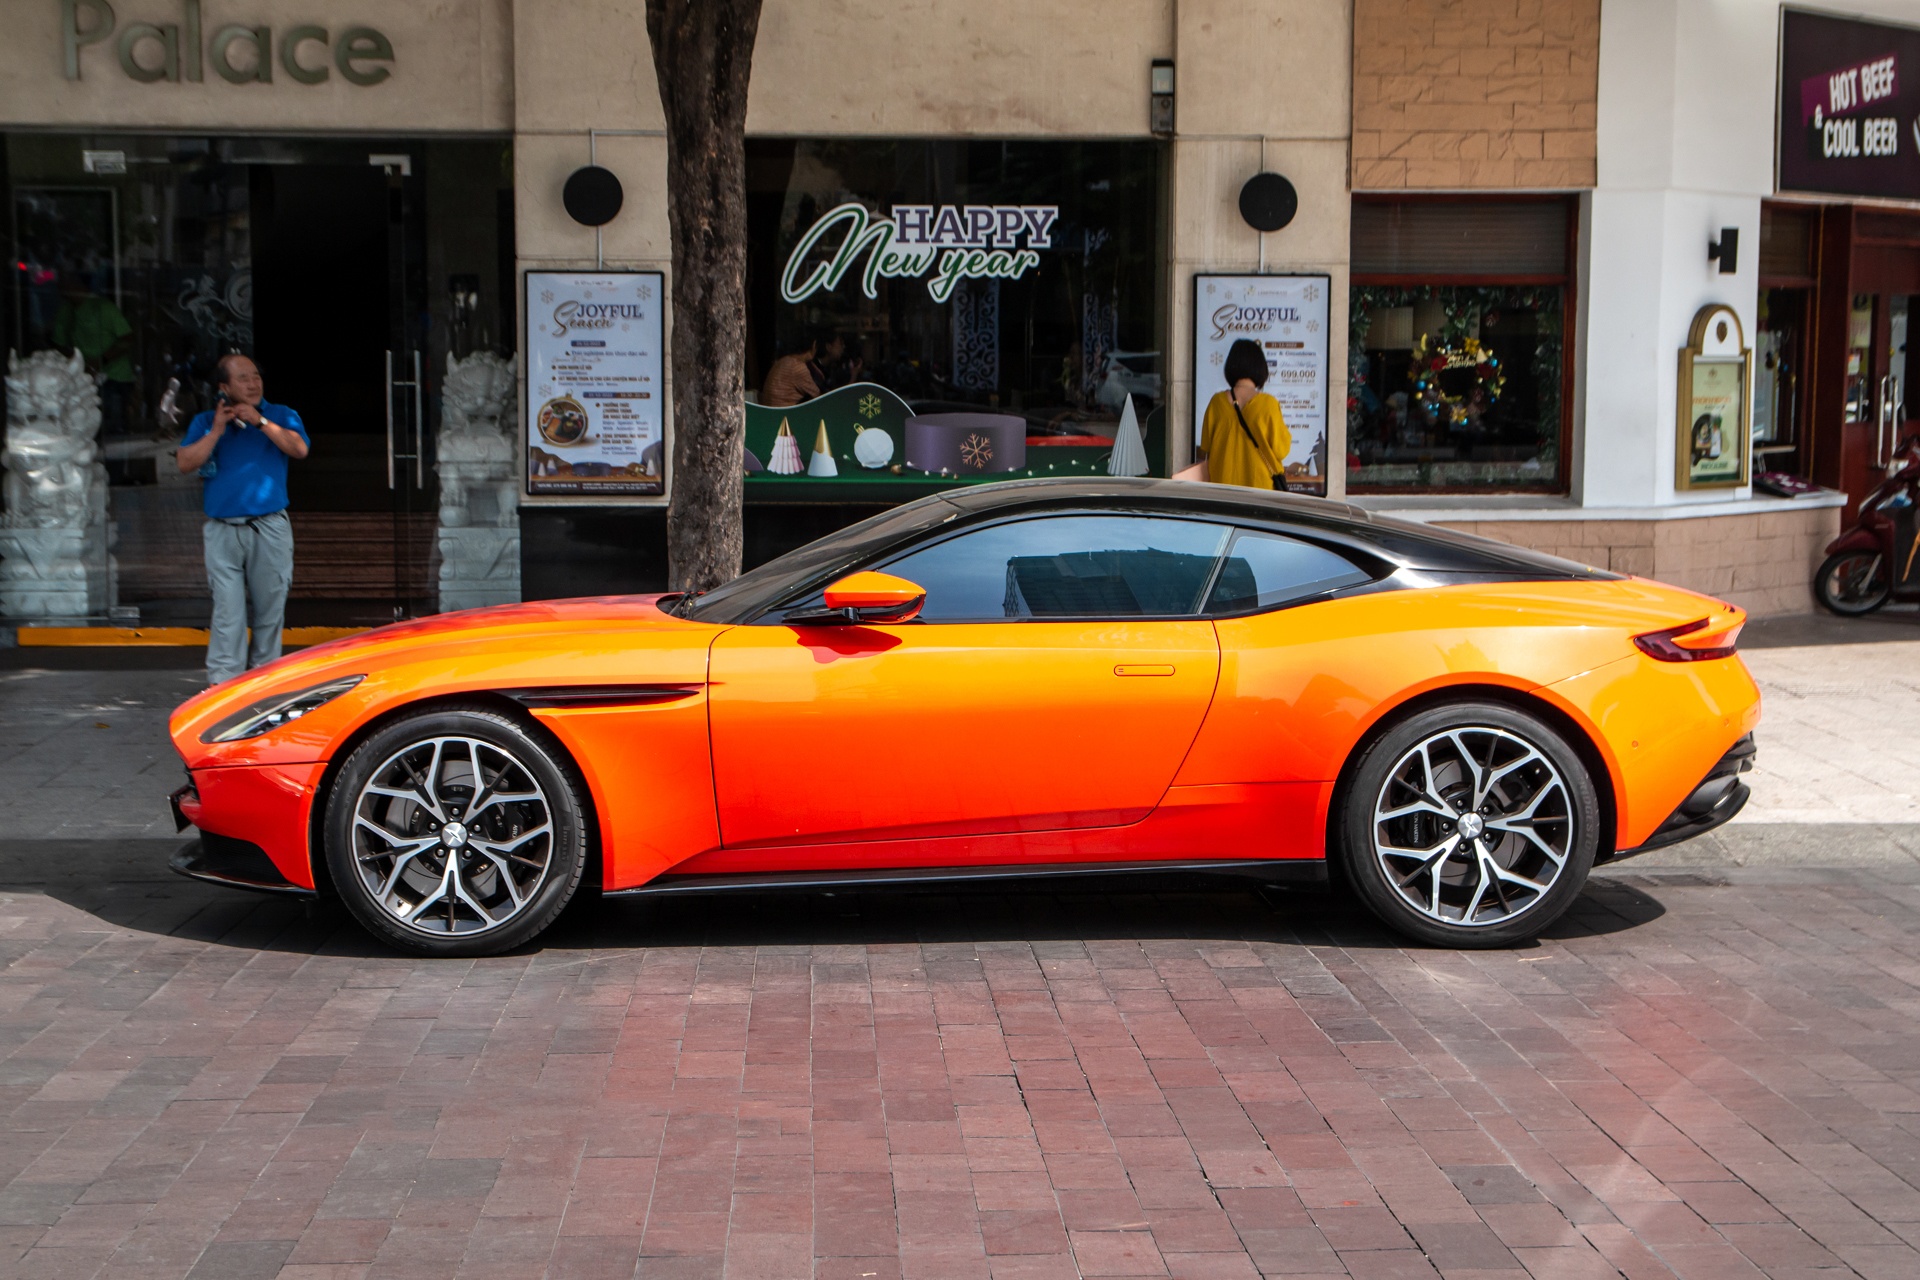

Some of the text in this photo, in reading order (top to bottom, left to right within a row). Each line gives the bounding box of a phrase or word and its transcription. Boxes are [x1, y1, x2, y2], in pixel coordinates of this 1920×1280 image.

[62, 0, 395, 86] Palace
[1829, 57, 1895, 113] HOT BEEF
[1814, 104, 1898, 158] & COOL BEER
[893, 206, 1057, 246] HAPPY
[783, 205, 1038, 301] New year
[552, 300, 613, 338] Season
[577, 304, 643, 319] JOYFUL
[1210, 303, 1271, 341] Season
[1235, 307, 1300, 322] JOYFUL
[1281, 369, 1316, 378] 699.000
